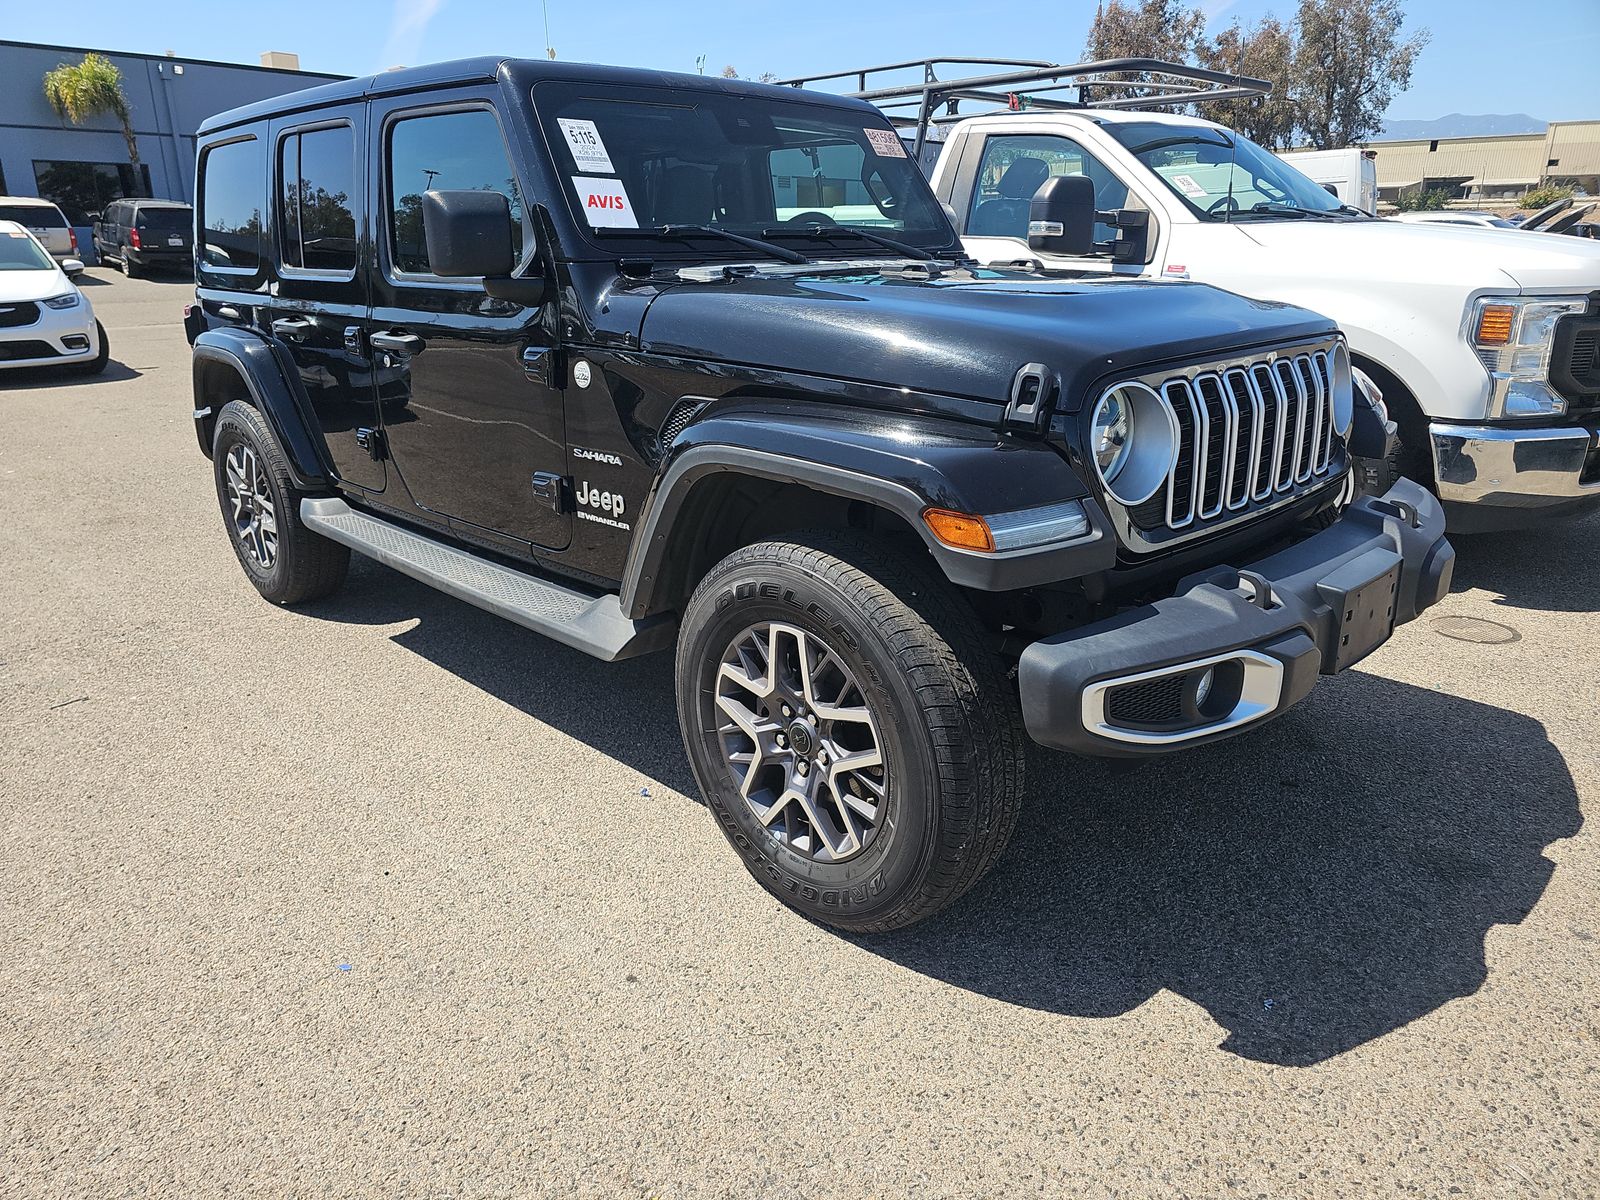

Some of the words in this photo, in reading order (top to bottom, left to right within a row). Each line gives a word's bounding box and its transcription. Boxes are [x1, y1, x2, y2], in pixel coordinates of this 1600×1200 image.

[569, 130, 596, 144] 5:115
[587, 194, 624, 210] AVIS
[573, 448, 623, 466] SAHARA
[576, 481, 625, 518] Jeep
[584, 513, 630, 531] WRANGLER
[713, 579, 861, 653] DUELER
[707, 793, 887, 908] BRIDGESTONE
